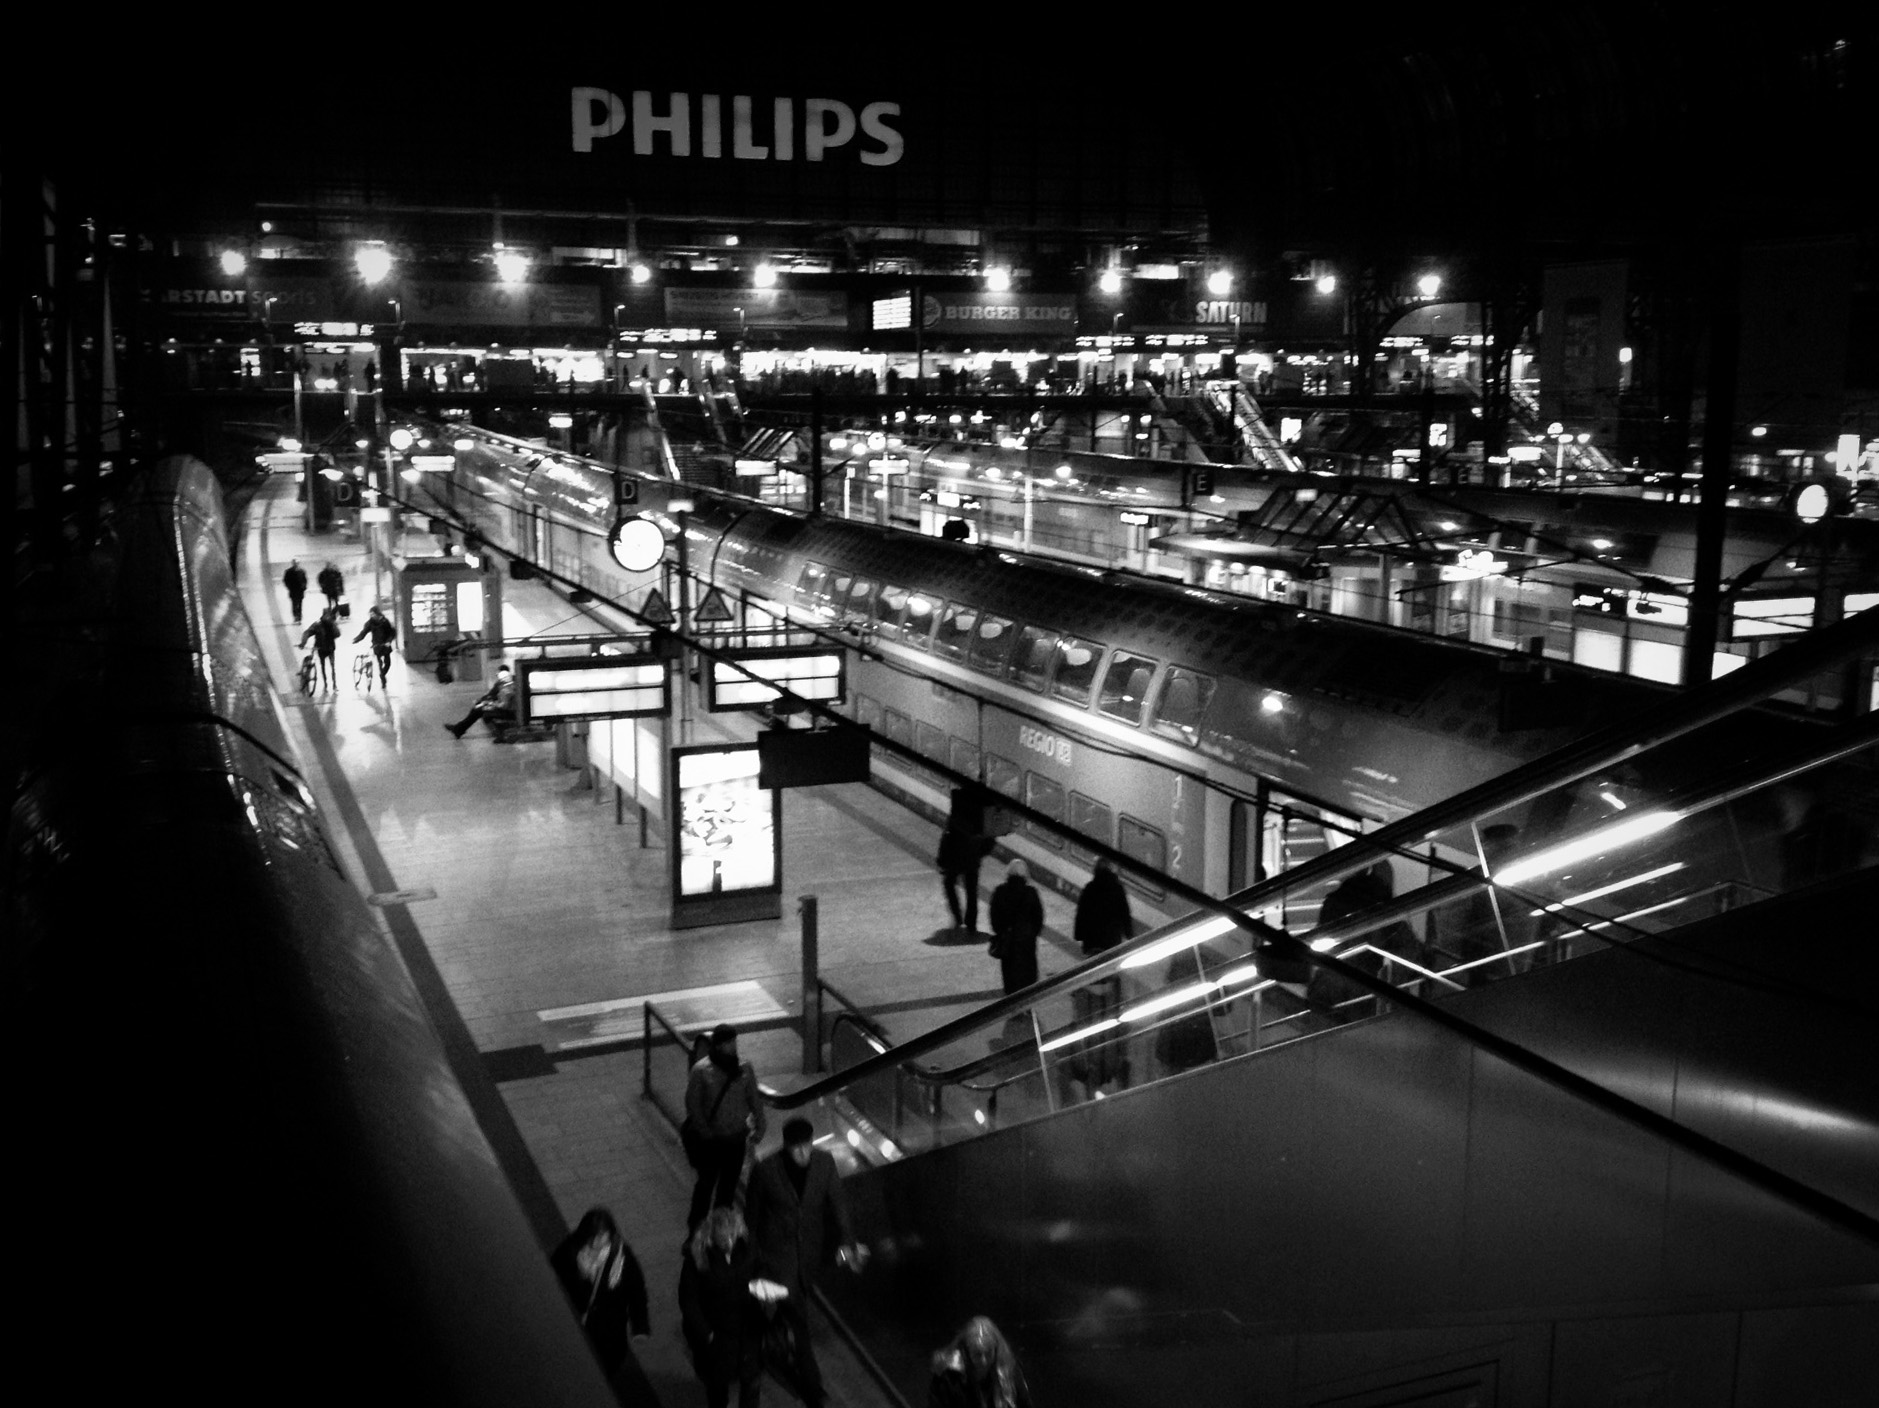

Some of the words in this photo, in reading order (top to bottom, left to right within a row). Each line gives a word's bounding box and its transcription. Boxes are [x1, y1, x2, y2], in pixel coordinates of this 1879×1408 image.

[571, 85, 905, 167] PHILIPS
[944, 305, 1020, 320] BURGER
[1023, 306, 1071, 320] KING
[1195, 300, 1268, 324] SATURN
[621, 481, 636, 500] D
[1196, 474, 1208, 492] E
[1174, 774, 1183, 799] 1
[1171, 845, 1183, 870] 2
